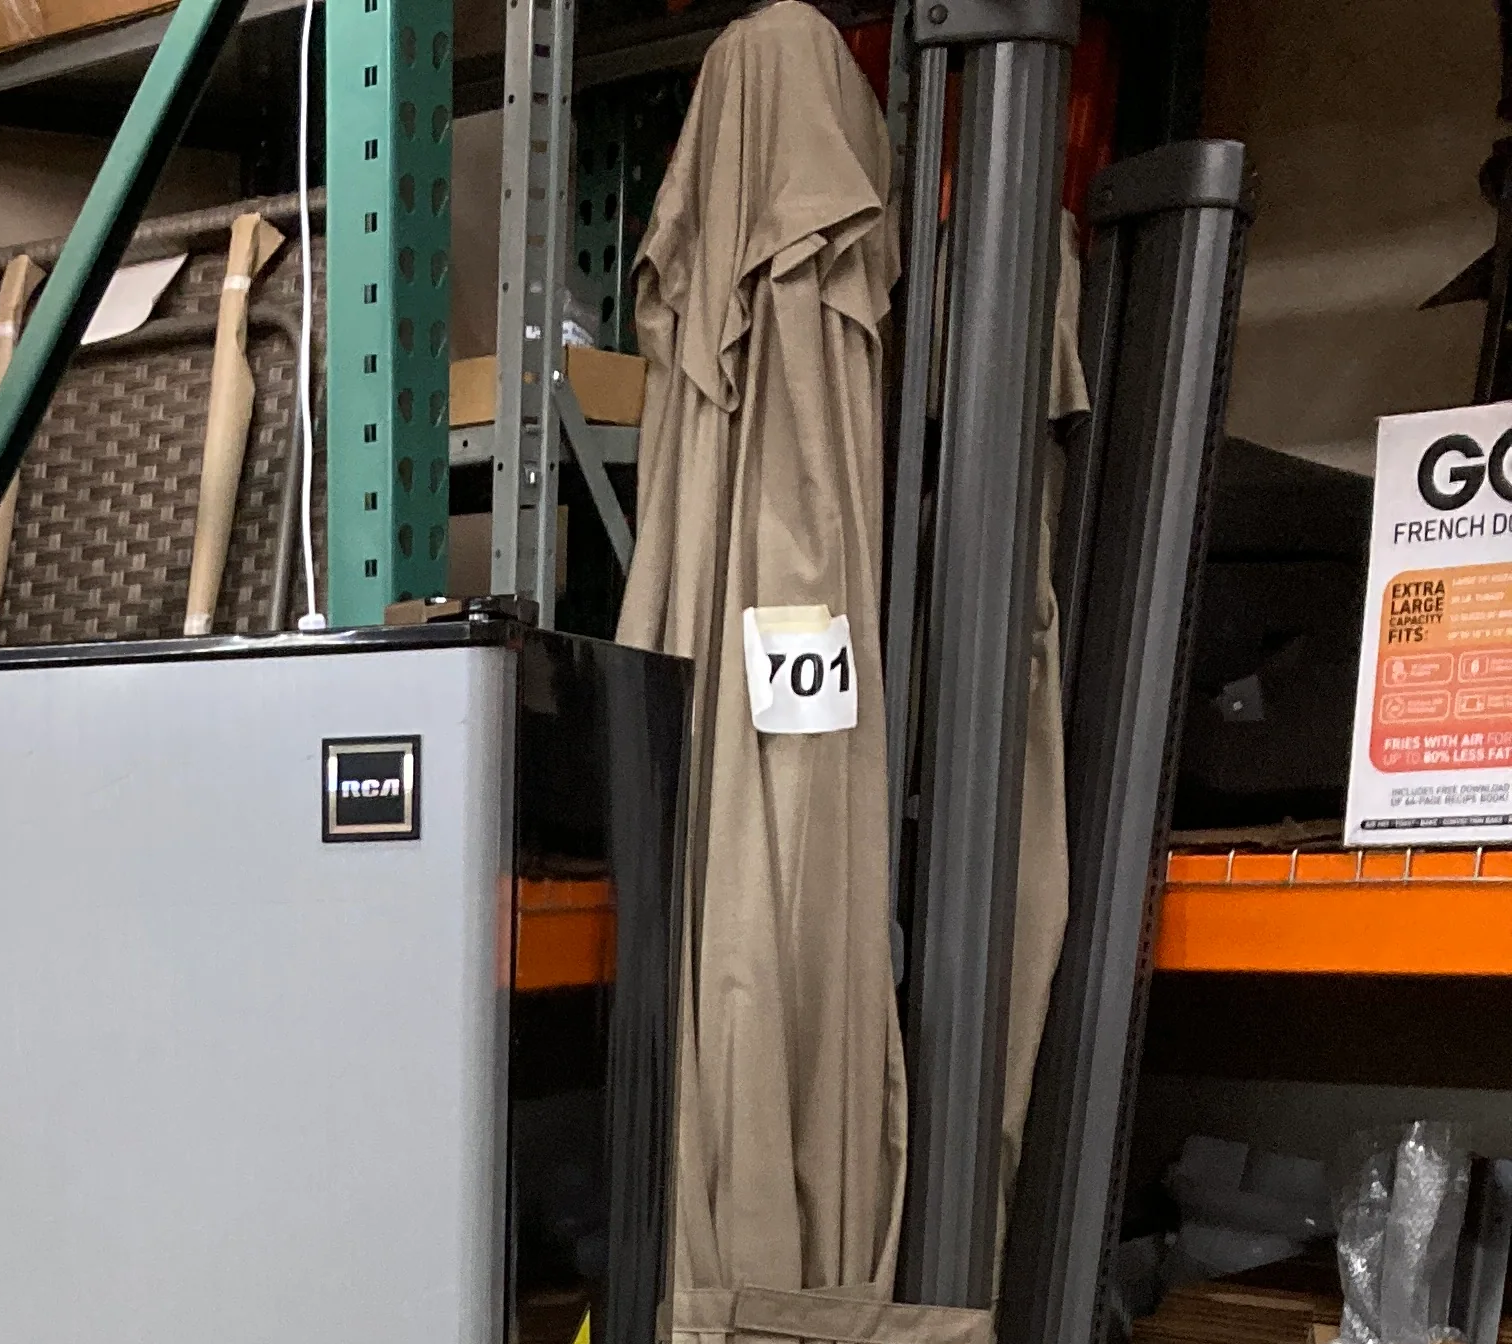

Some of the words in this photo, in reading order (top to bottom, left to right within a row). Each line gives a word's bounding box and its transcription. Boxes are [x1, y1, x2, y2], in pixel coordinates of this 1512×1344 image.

[1394, 514, 1485, 544] FRENCH
[1391, 579, 1445, 600] EXTRA
[1390, 597, 1444, 616] LARGE
[1388, 614, 1443, 627] CAPACITY
[1387, 626, 1429, 644] FITS:
[1384, 734, 1420, 750] FRIES
[1423, 734, 1458, 748] WITH
[1461, 733, 1484, 746] AIR
[1382, 752, 1402, 766] UP
[1453, 748, 1484, 762] LESS
[341, 779, 400, 798] RCA
